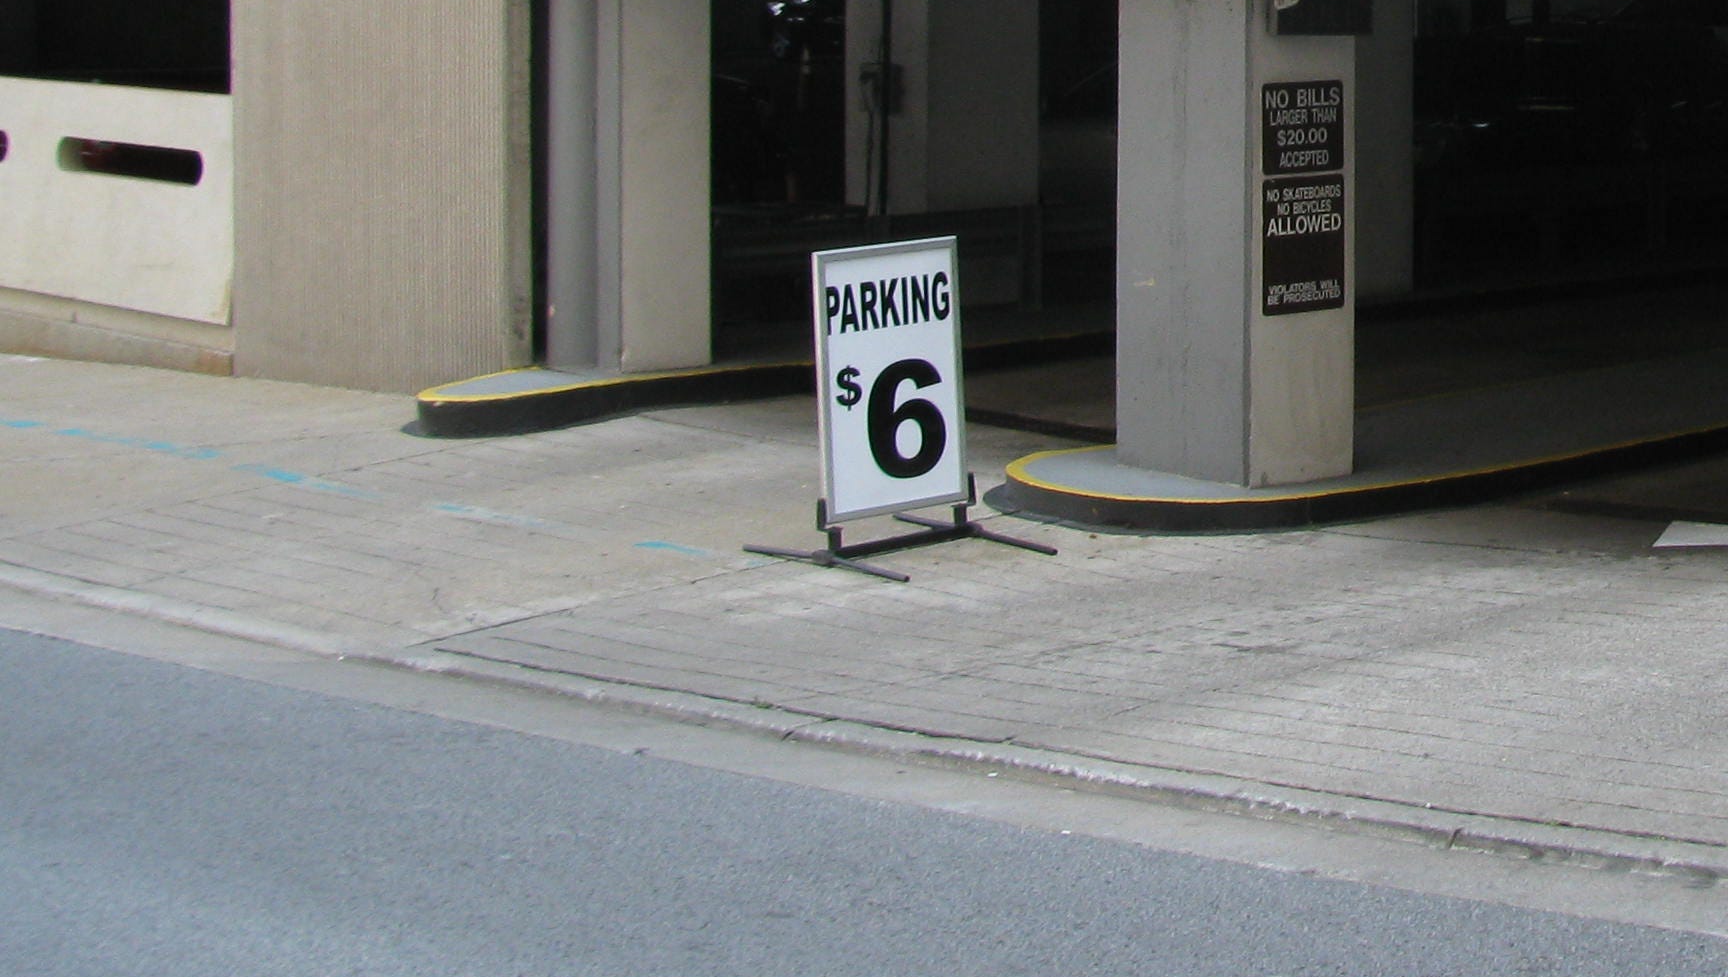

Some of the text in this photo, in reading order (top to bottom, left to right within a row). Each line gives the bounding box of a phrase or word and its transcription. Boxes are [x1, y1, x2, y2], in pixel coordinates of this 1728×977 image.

[1265, 87, 1340, 109] NO BILLS
[1270, 107, 1337, 126] LARGER THAN
[1277, 127, 1328, 147] $20.00
[1279, 149, 1329, 168] ACCEPTED
[1267, 184, 1341, 202] NO SKATEBOARDS
[1277, 199, 1331, 215] NO BICYCLES
[1267, 213, 1341, 237] ALLOWED
[1267, 288, 1341, 306] BE PROSECUTED
[1268, 279, 1340, 296] VIOLATORS WILL
[825, 271, 950, 336] PARKING
